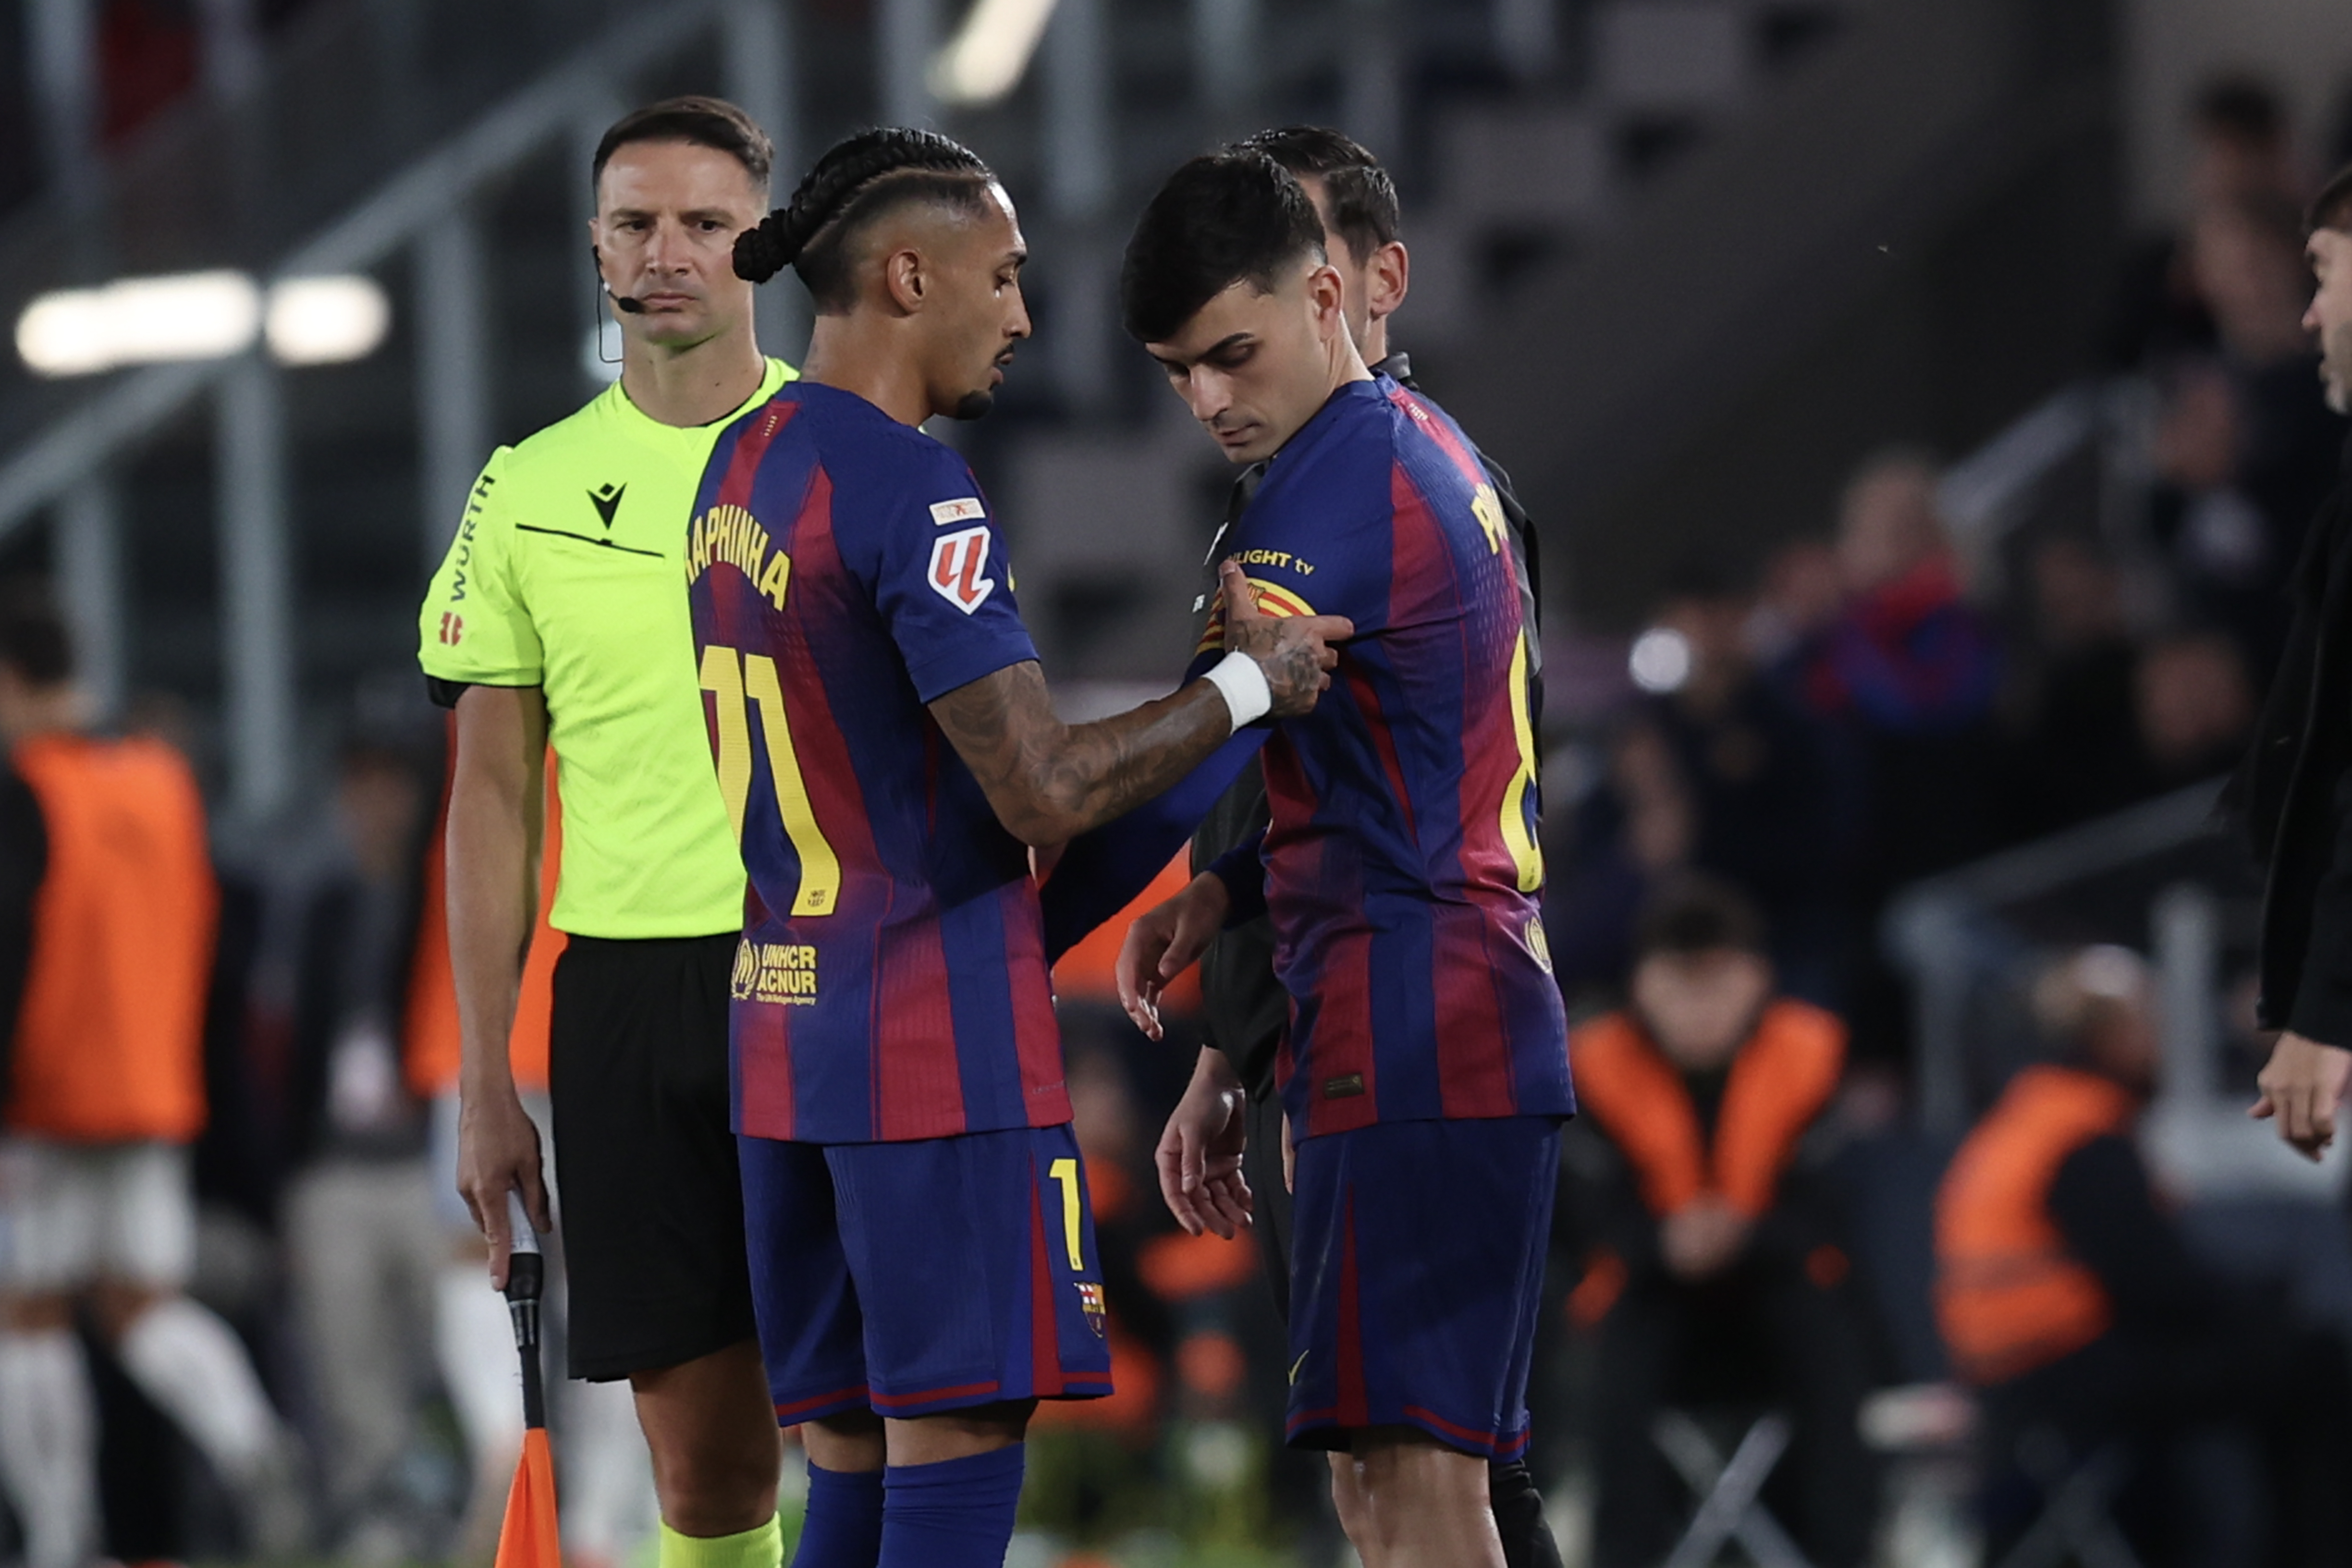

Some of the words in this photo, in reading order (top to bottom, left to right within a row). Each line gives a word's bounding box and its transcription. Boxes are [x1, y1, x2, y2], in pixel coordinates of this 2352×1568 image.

[1295, 558, 1314, 576] tv
[699, 645, 841, 917] 11
[762, 943, 817, 969] UNHCR
[756, 968, 817, 994] ACNUR
